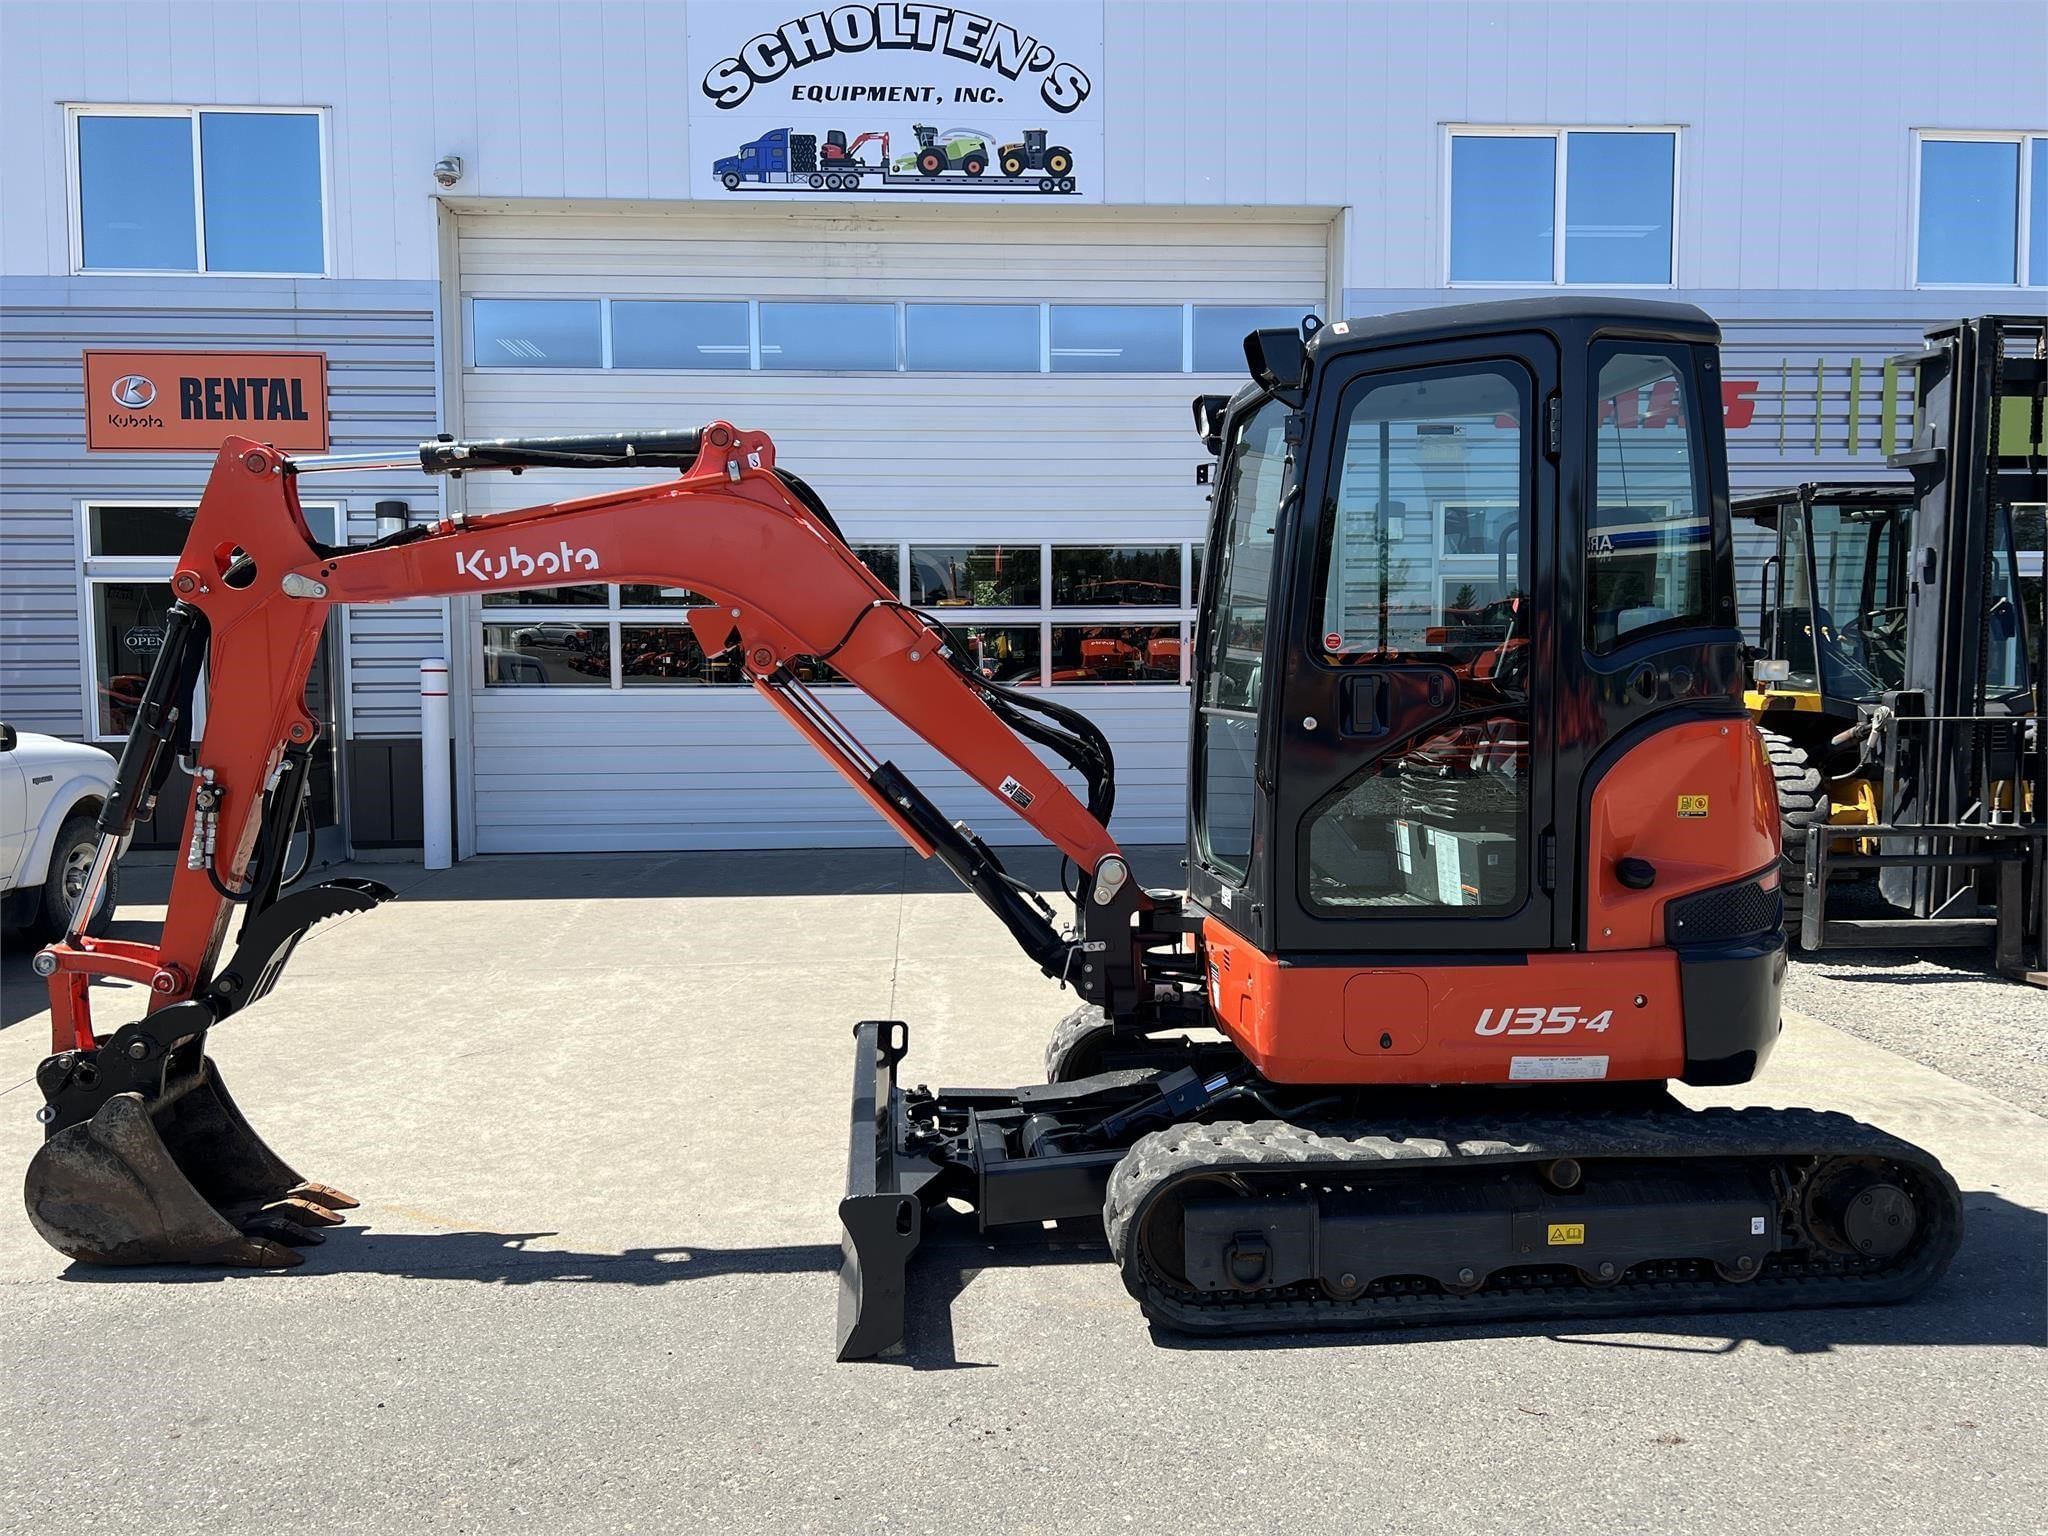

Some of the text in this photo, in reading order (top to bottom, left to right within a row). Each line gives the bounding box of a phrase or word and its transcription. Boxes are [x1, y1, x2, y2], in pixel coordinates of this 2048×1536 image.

[702, 2, 1091, 113] SCHOLTEN'S
[791, 85, 1004, 105] EQUIPMENT, INC.
[179, 377, 308, 421] RENTAL
[108, 414, 163, 428] Kubota
[455, 541, 600, 581] Kubota
[1474, 1006, 1614, 1036] U35-4
